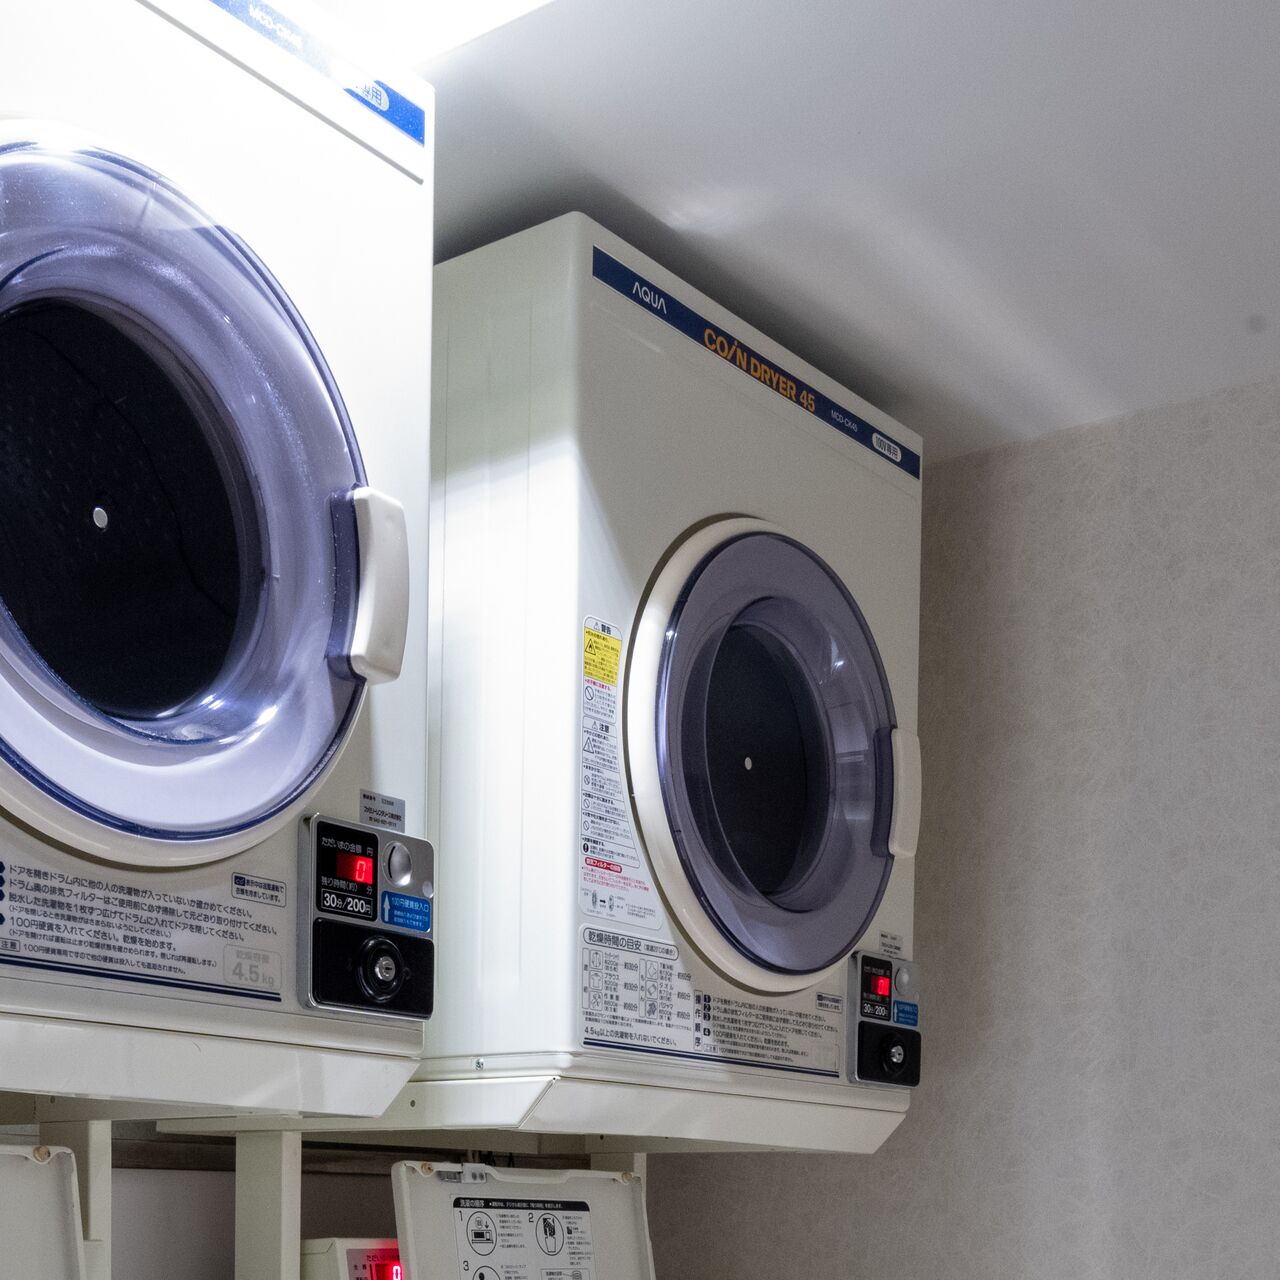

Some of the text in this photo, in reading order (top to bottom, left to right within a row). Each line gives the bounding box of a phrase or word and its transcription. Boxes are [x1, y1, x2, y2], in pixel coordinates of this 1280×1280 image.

[633, 282, 666, 314] AQUA
[751, 357, 796, 400] DRYER
[800, 390, 815, 413] 45
[367, 848, 373, 856] 円
[356, 861, 366, 881] 0
[324, 893, 372, 914] 30分/200円
[588, 931, 641, 951] 乾燥時間の目安
[232, 962, 274, 985] 4.5 kg
[459, 1211, 463, 1221] 1
[529, 1213, 534, 1223] 2
[463, 1261, 469, 1271] 3
